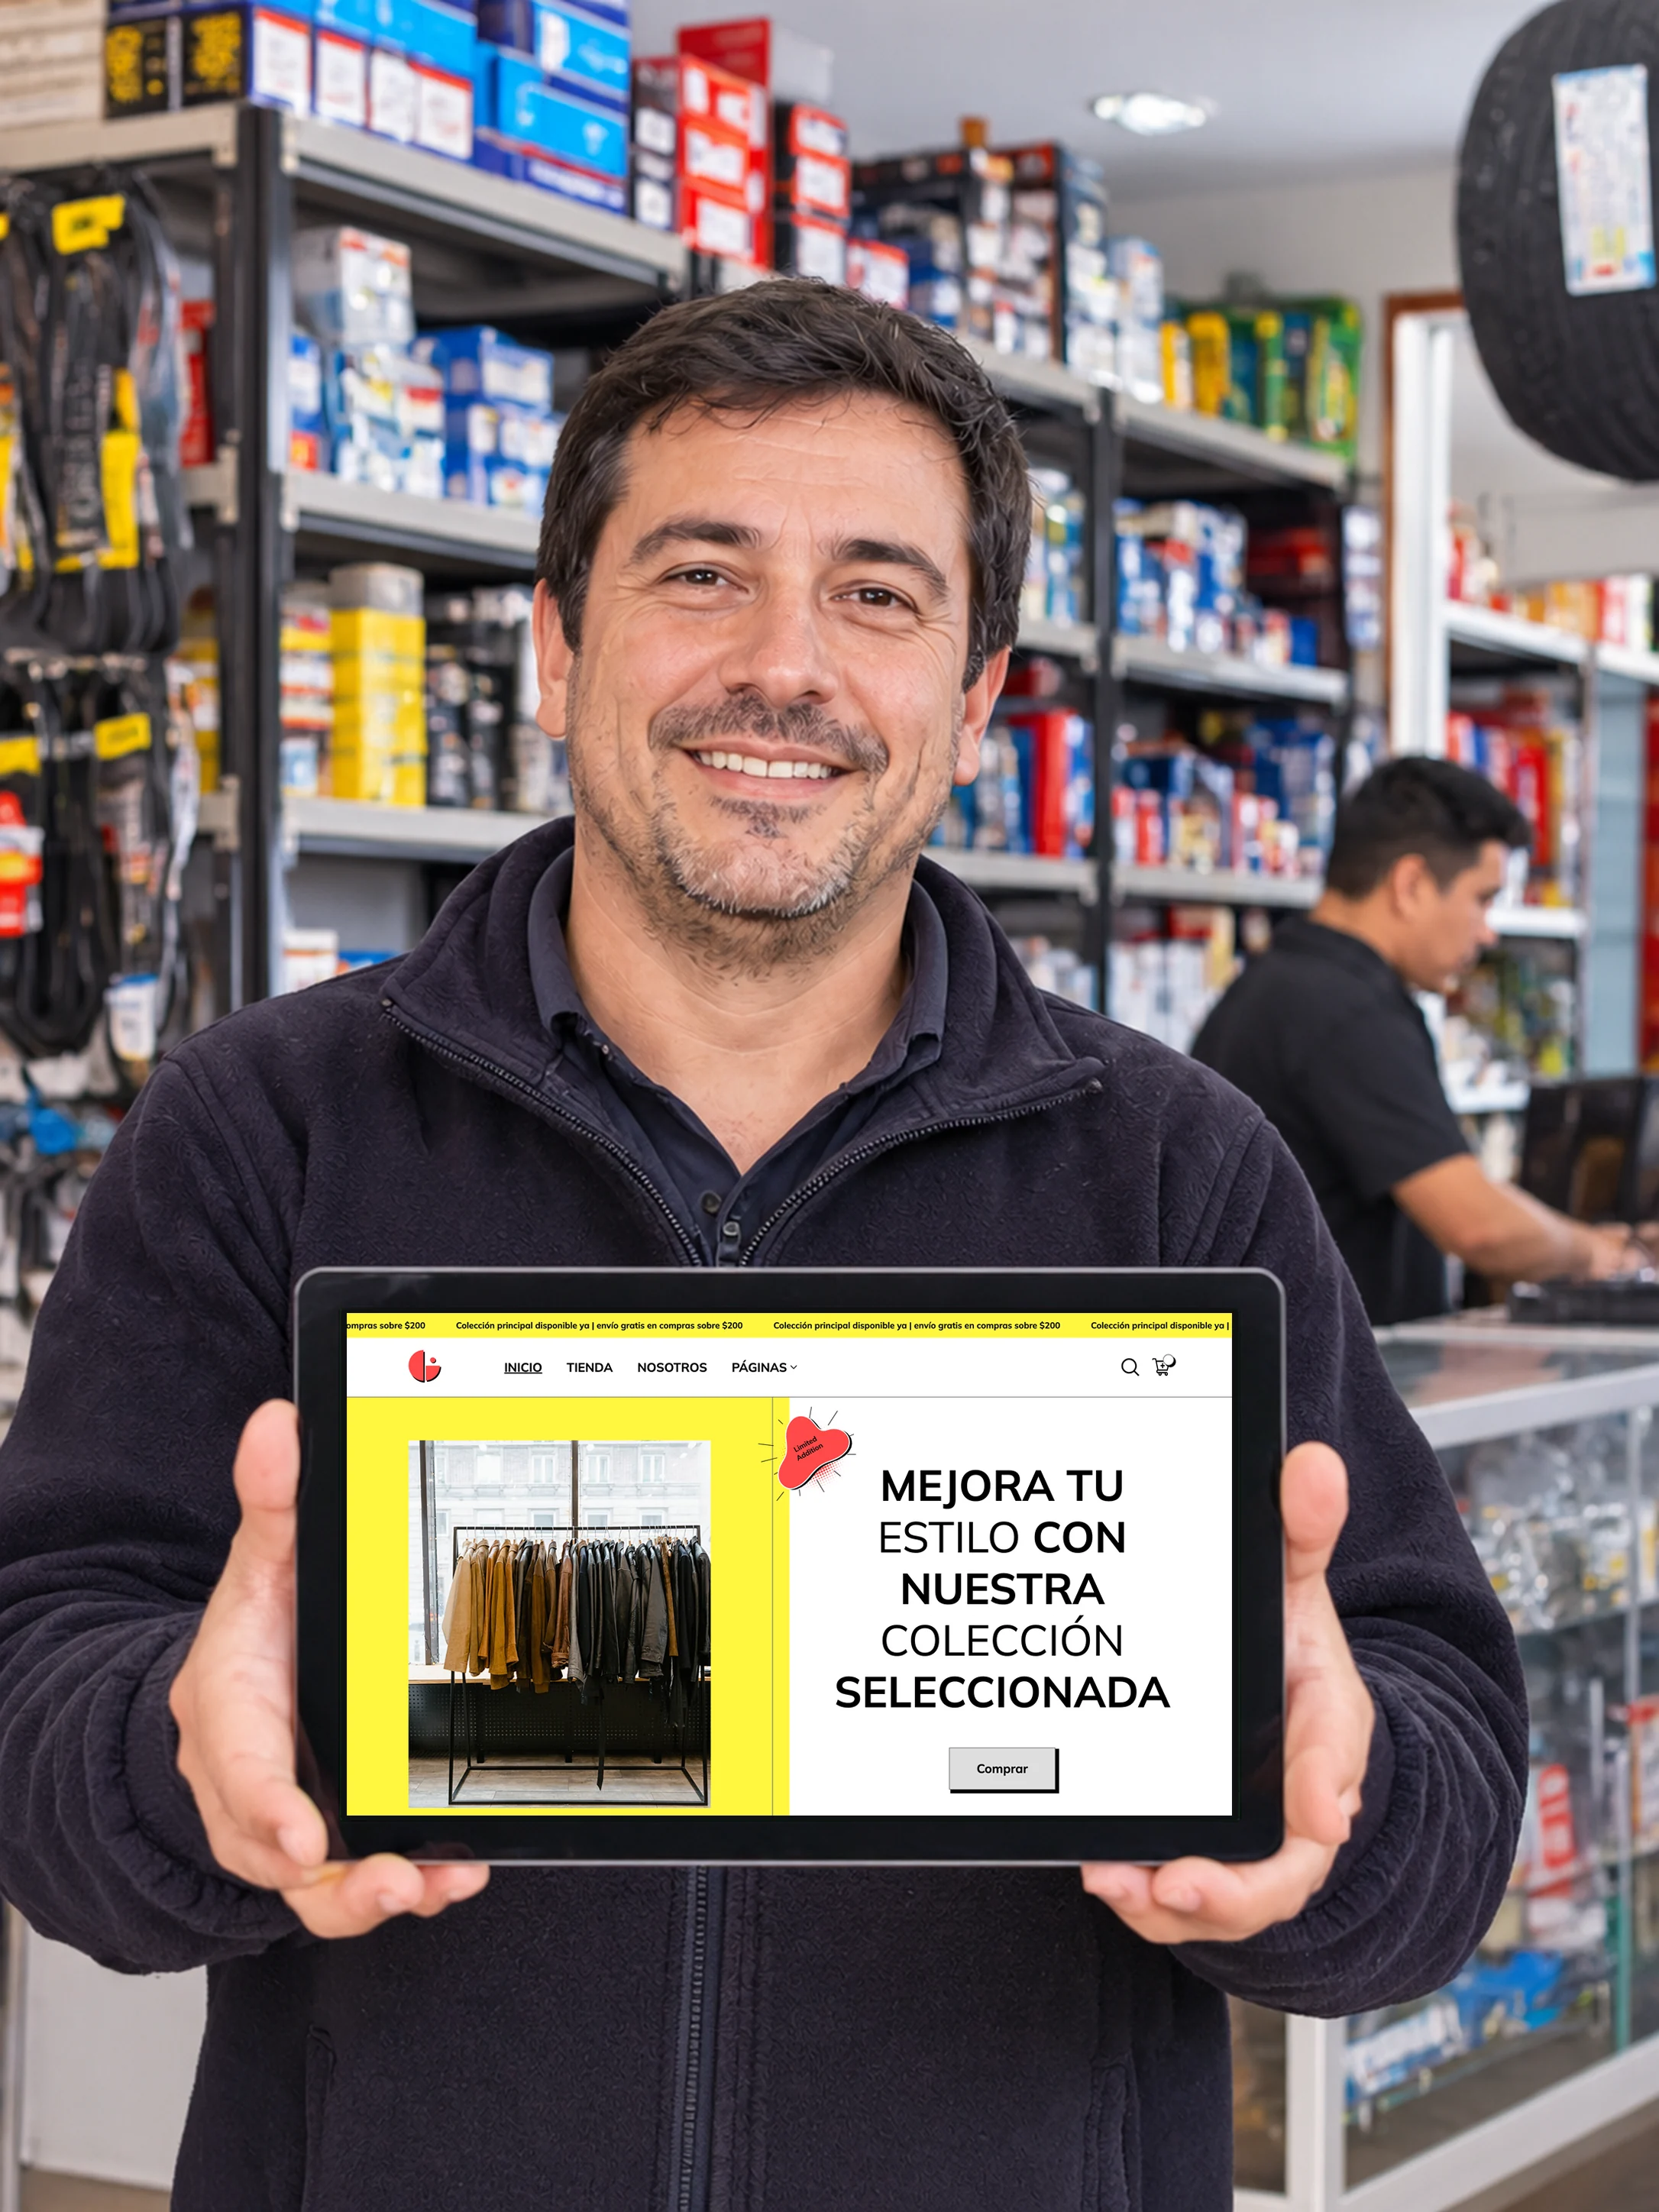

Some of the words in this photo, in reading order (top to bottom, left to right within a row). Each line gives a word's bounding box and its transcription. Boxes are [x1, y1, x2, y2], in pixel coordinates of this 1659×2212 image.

[347, 1323, 377, 1331] ompras
[404, 1321, 425, 1330] $200
[497, 1321, 533, 1331] principal
[535, 1321, 577, 1331] disponible
[579, 1323, 590, 1331] ya
[620, 1321, 645, 1331] gratis
[658, 1323, 695, 1331] compras
[722, 1321, 743, 1330] $200
[814, 1321, 851, 1331] principal
[852, 1321, 895, 1331] disponible
[897, 1323, 907, 1331] ya
[938, 1321, 962, 1331] gratis
[976, 1323, 1013, 1331] compras
[1039, 1321, 1061, 1331] $200
[1132, 1321, 1168, 1331] principal
[1169, 1321, 1212, 1331] disponible
[1214, 1323, 1224, 1331] ya
[504, 1363, 542, 1373] INICIO
[567, 1363, 613, 1372] TIENDA
[639, 1363, 707, 1372] NOSOTROS
[732, 1359, 787, 1373] PÁGINAS
[794, 1436, 817, 1453] Limited
[797, 1444, 823, 1461] Addition
[883, 1470, 1055, 1509] MEJORA
[1067, 1470, 1122, 1501] TU
[881, 1522, 1018, 1553] ESTILO
[1035, 1522, 1124, 1553] CON
[903, 1573, 1104, 1605] NUESTRA
[882, 1615, 1121, 1656] COLECCIÓN
[836, 1677, 1170, 1708] SELECCIONADA
[977, 1764, 1028, 1776] Comprar
